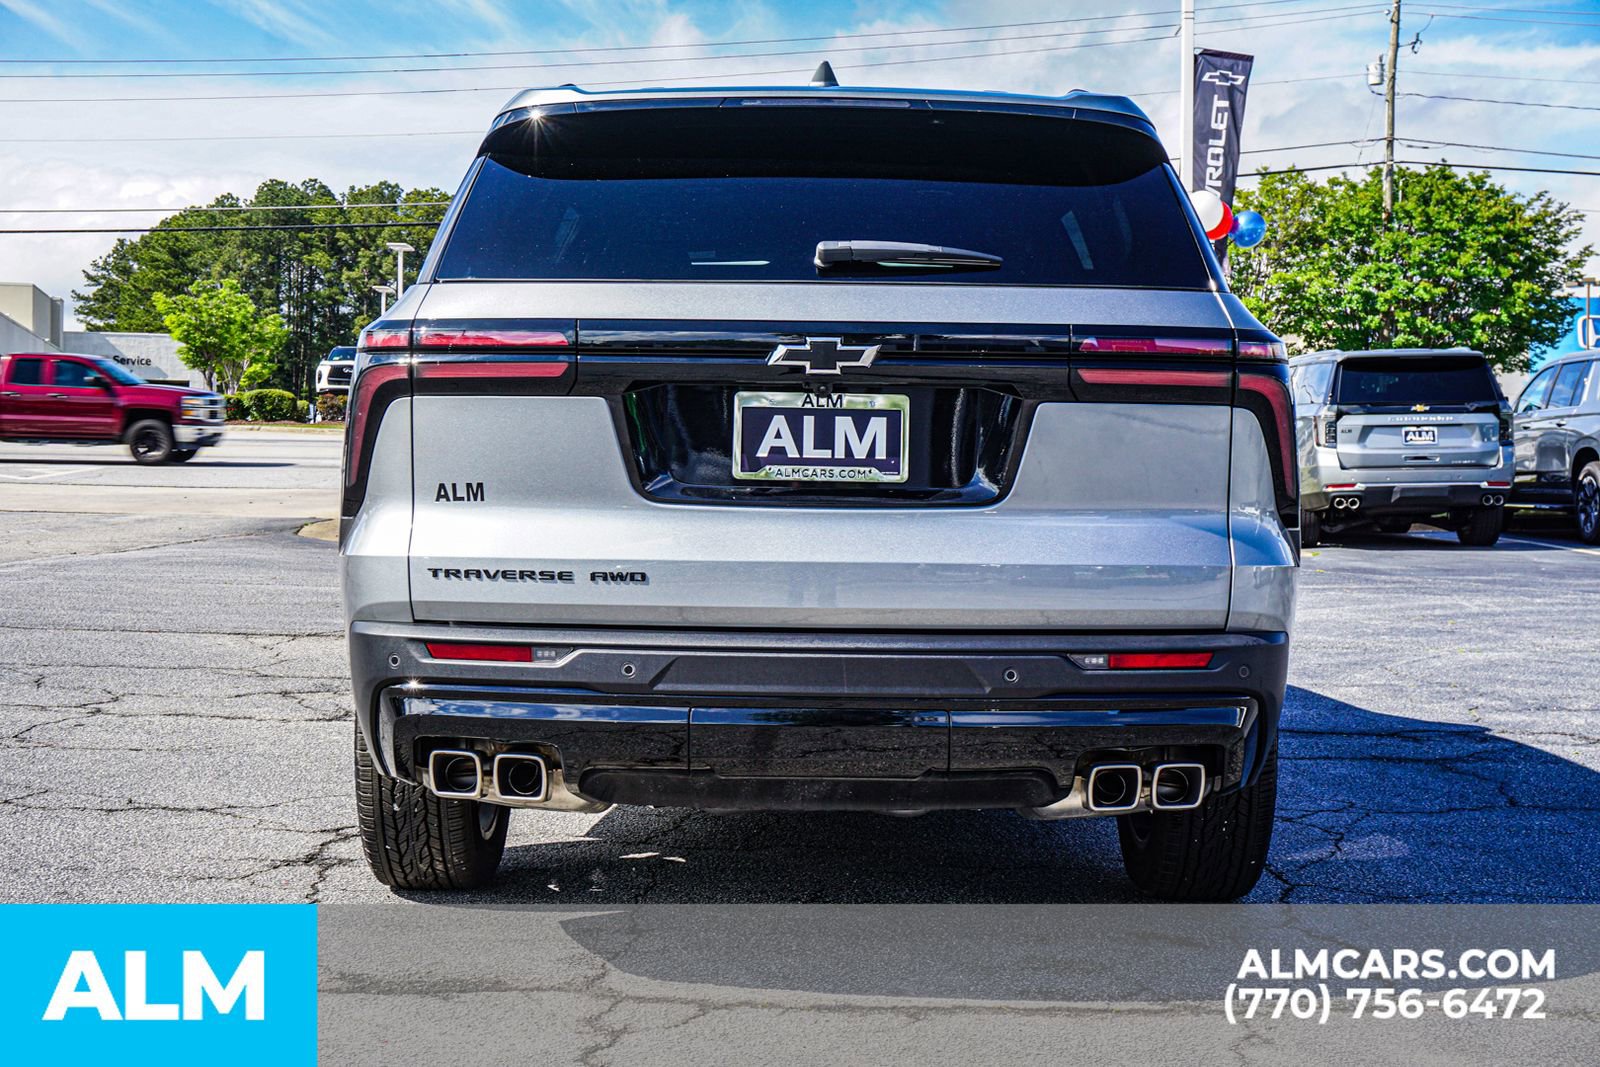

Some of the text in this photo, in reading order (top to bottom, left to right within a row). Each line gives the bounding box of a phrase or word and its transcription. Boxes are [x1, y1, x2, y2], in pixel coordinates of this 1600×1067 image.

[113, 355, 152, 366] Service
[801, 393, 843, 408] ALM
[755, 414, 888, 460] ALM
[1406, 431, 1434, 441] ALM
[774, 467, 867, 479] ALMCARS.COM
[435, 482, 485, 502] ALM
[427, 568, 649, 584] TRAVERSE AWD
